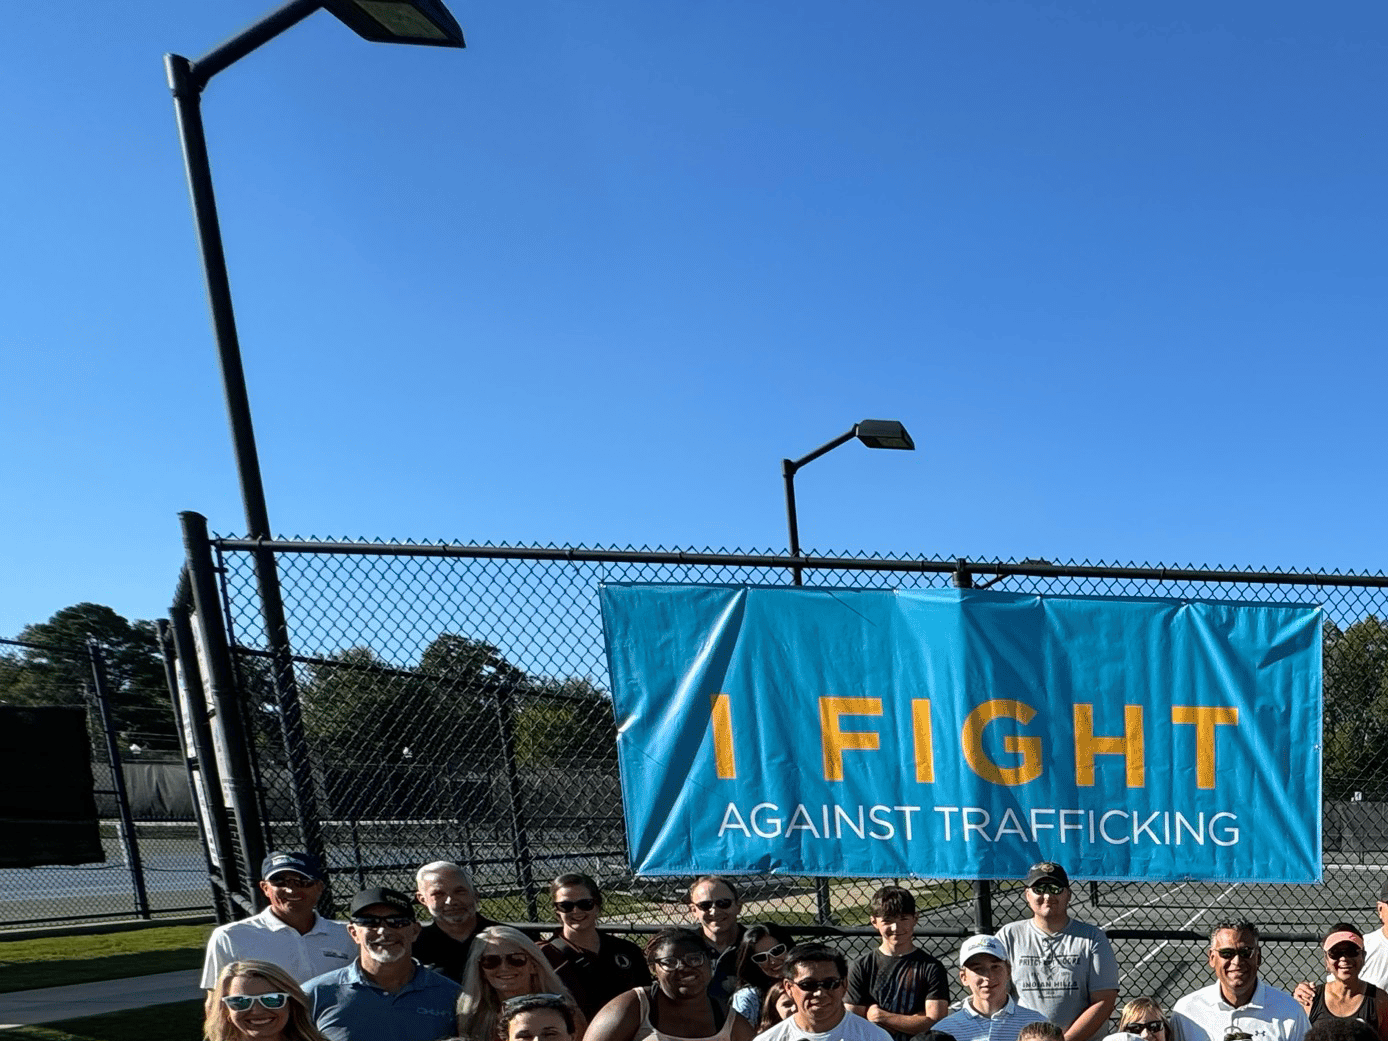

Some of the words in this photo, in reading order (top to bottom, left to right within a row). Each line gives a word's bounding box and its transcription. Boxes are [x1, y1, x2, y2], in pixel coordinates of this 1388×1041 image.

[710, 693, 736, 779] I
[818, 696, 1239, 790] FIGHT
[717, 802, 920, 841] AGAINST
[933, 806, 1239, 847] TRAFFICKING
